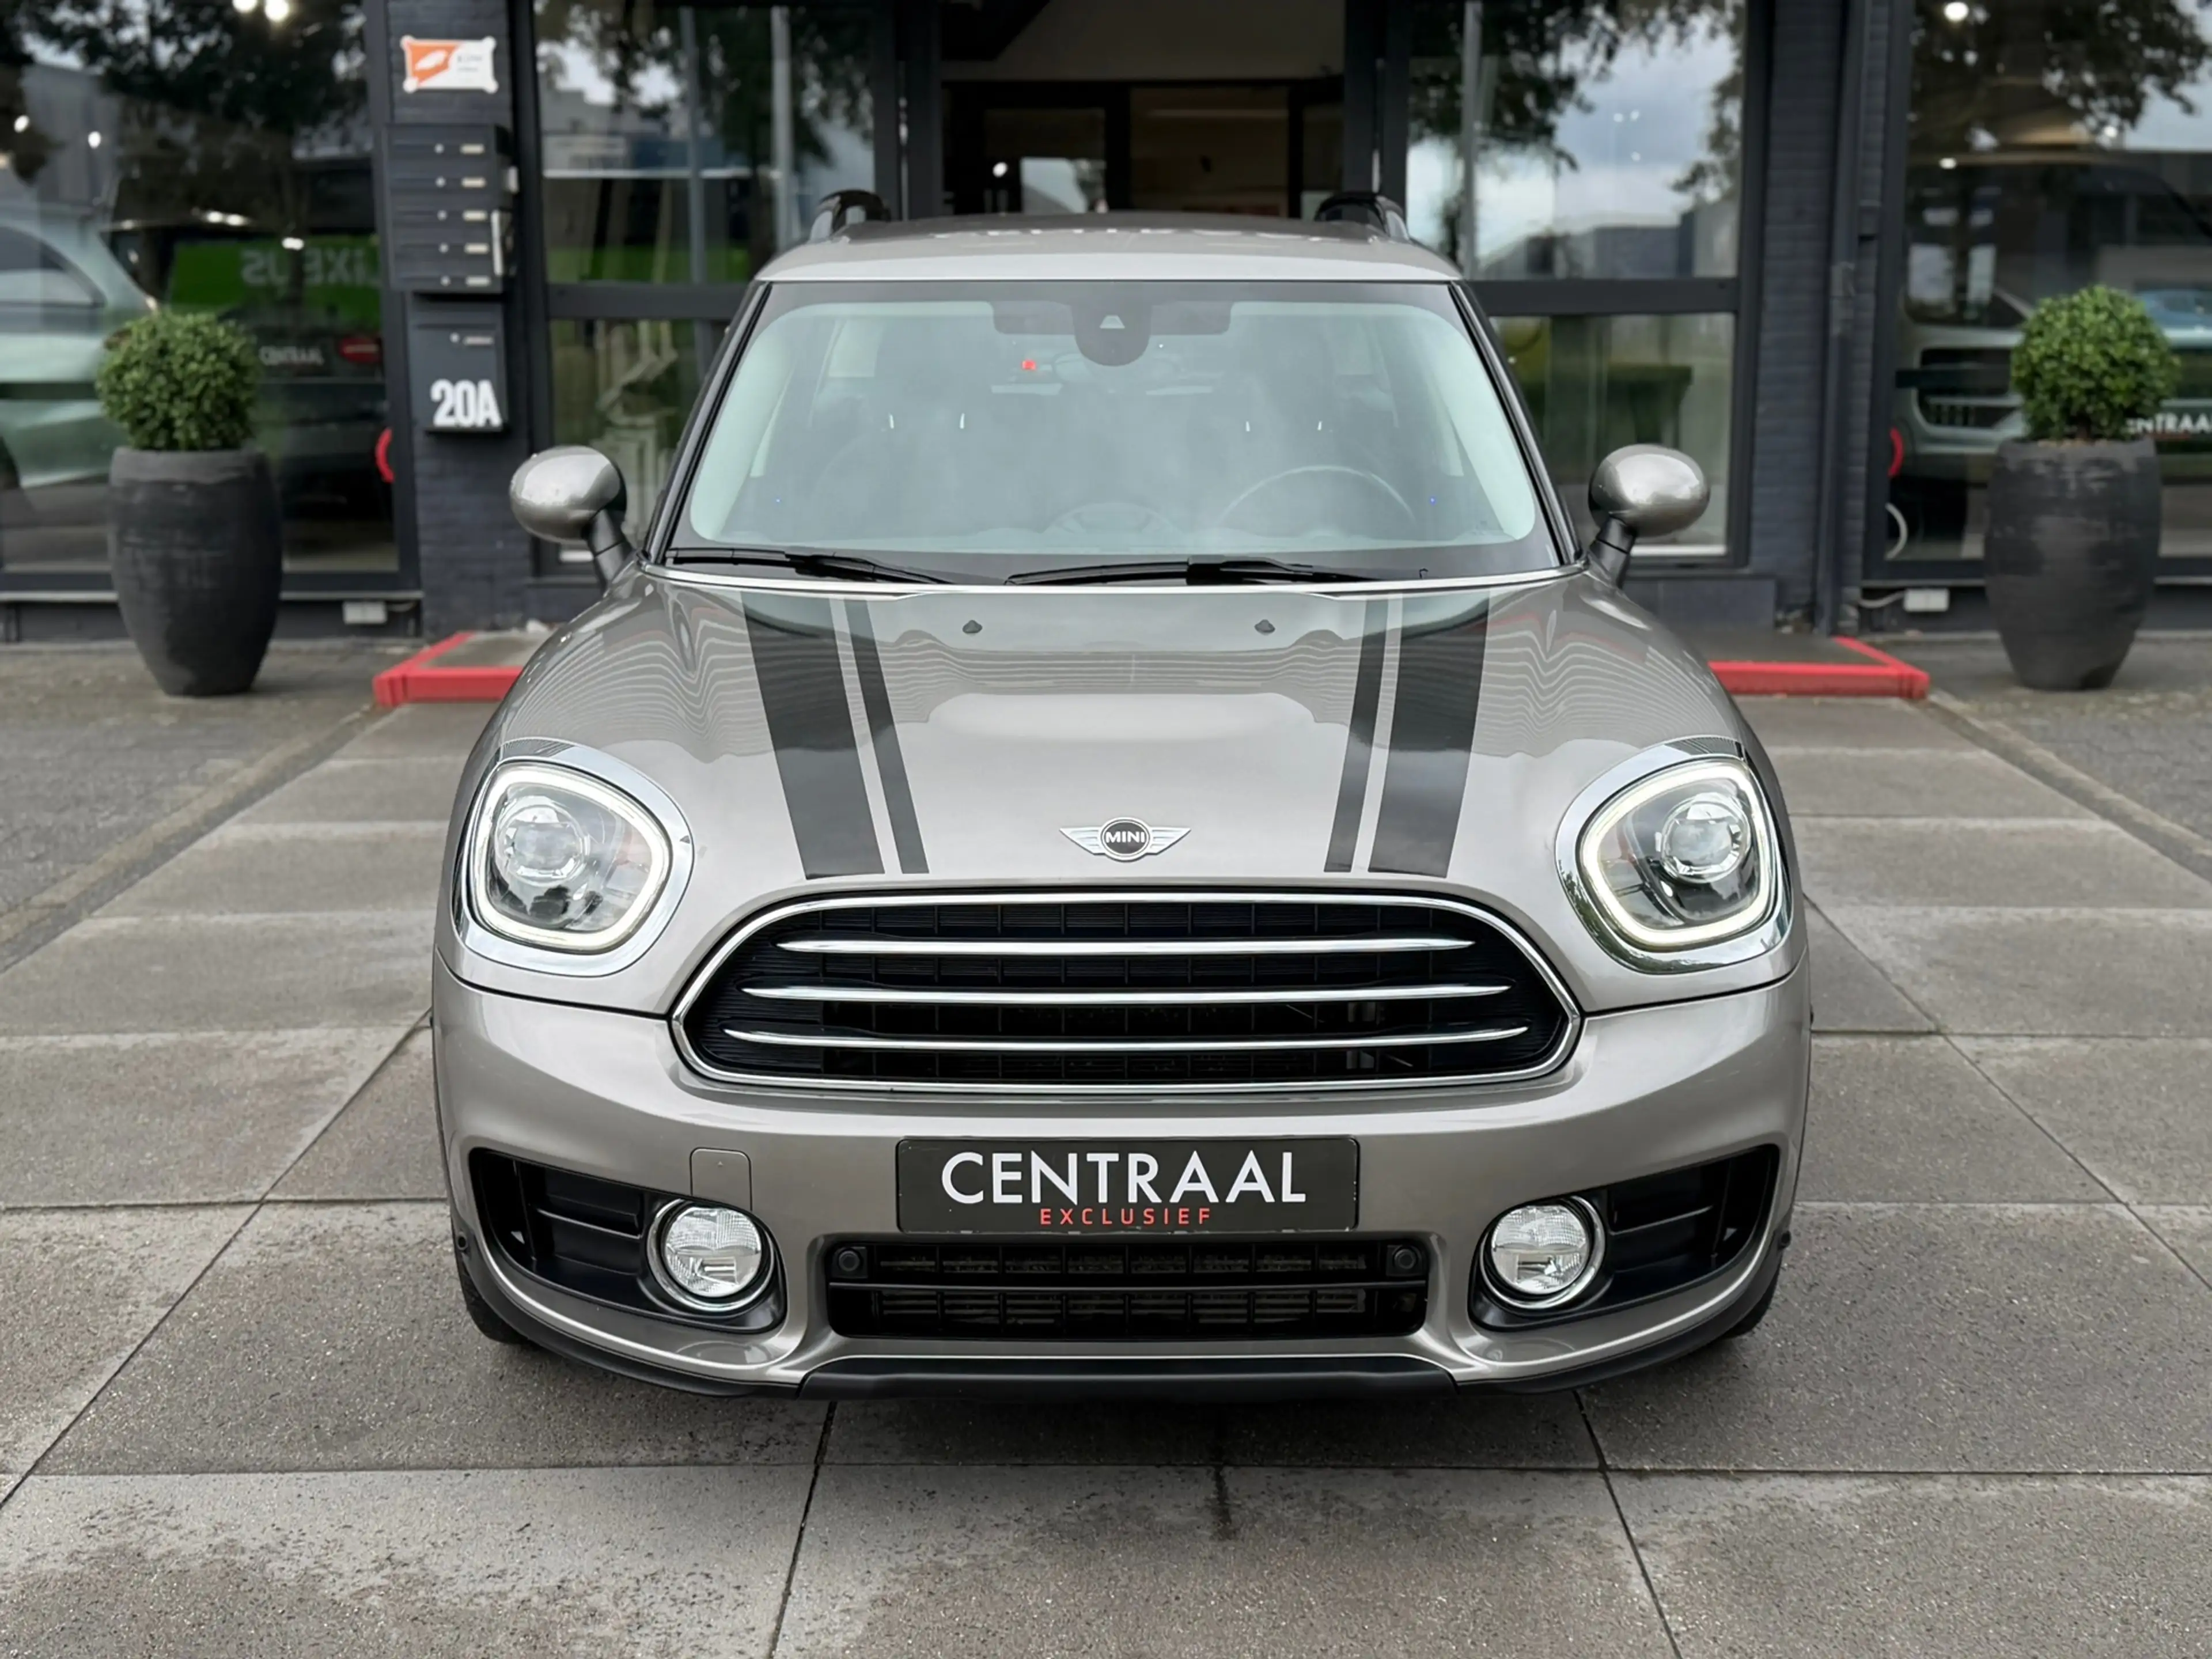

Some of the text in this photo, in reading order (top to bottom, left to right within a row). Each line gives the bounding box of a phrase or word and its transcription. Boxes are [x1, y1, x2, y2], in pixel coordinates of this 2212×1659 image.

[430, 378, 503, 427] 20A
[2124, 412, 2212, 434] ENTRAA
[1105, 831, 1145, 843] MINI
[942, 1150, 1306, 1205] CENTRAAL
[1040, 1208, 1211, 1225] EXCLUSIEF
